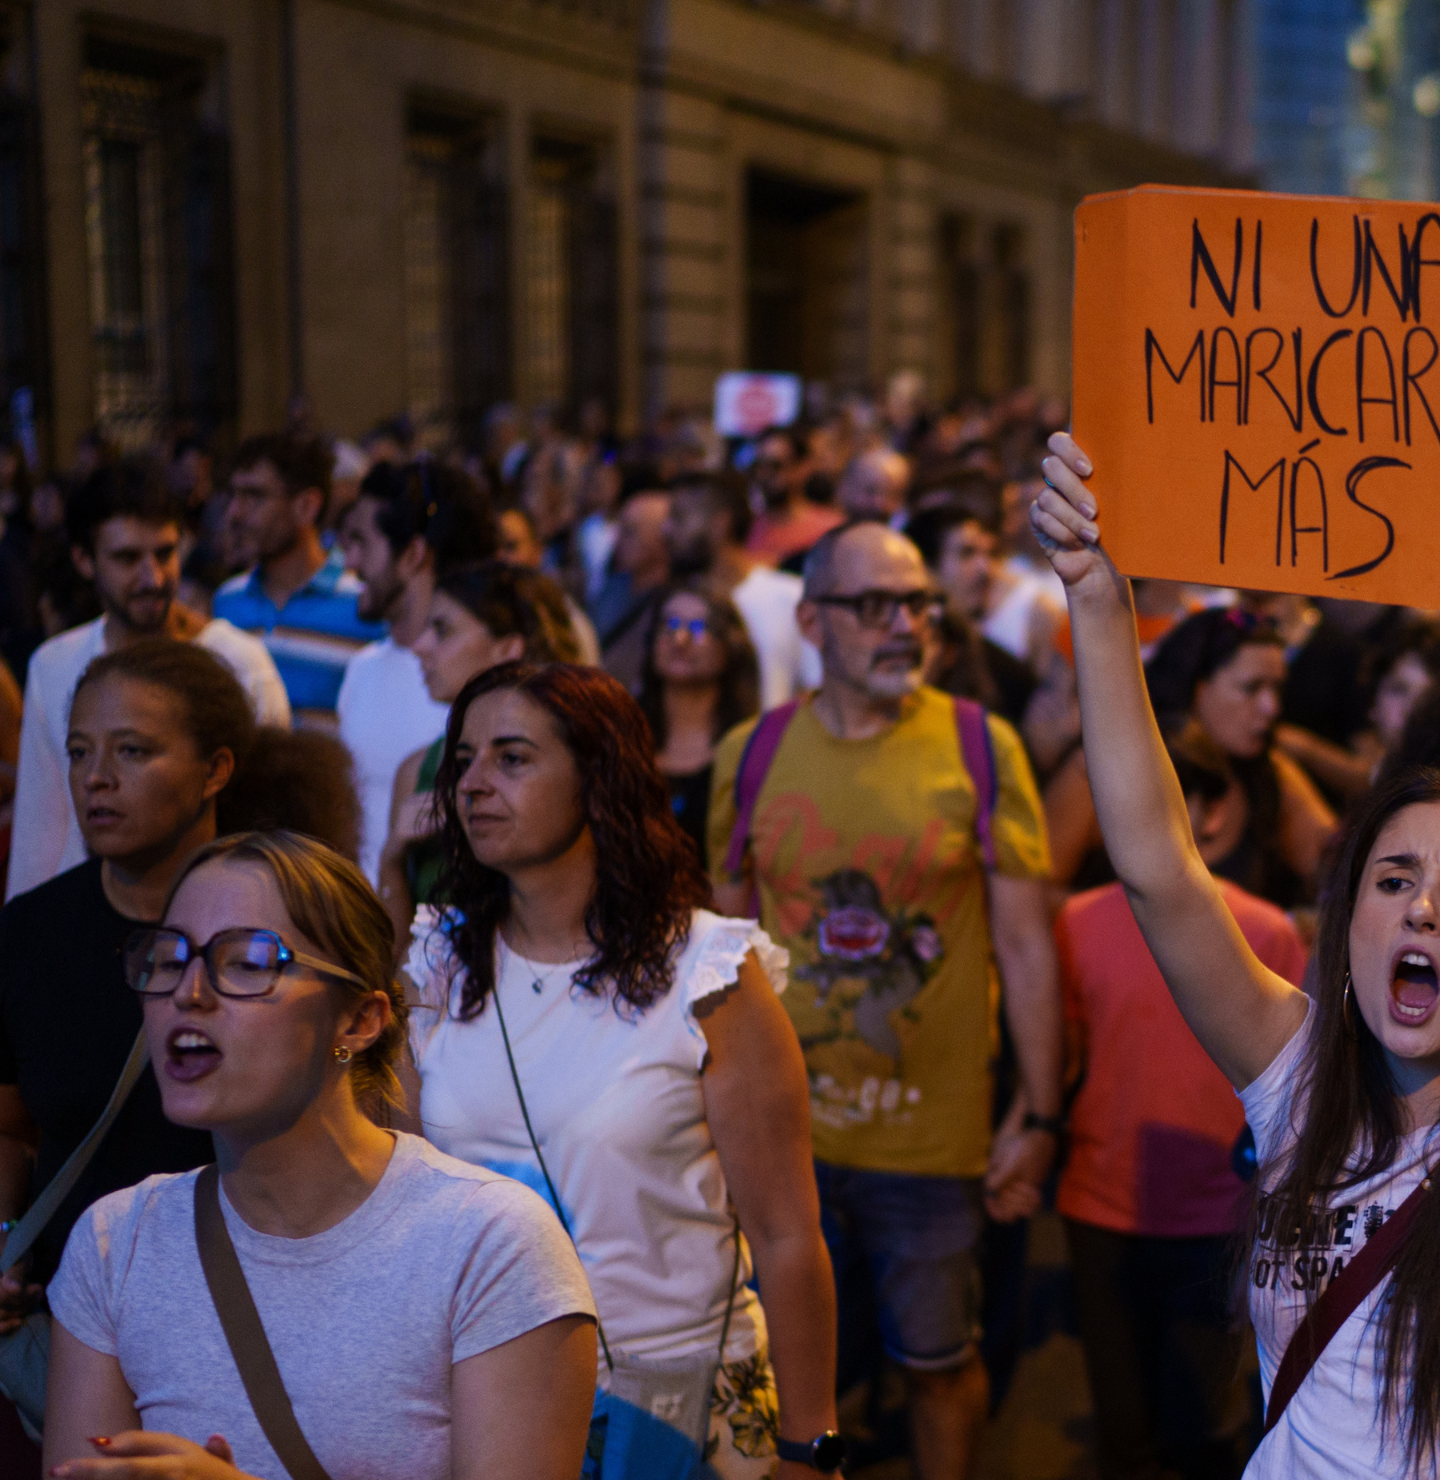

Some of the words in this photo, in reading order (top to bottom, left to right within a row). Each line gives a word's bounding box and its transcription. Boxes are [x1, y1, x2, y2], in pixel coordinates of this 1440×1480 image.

[1190, 217, 1261, 318] NI
[1219, 438, 1412, 581] MÁS
[1291, 1256, 1356, 1291] SPA
